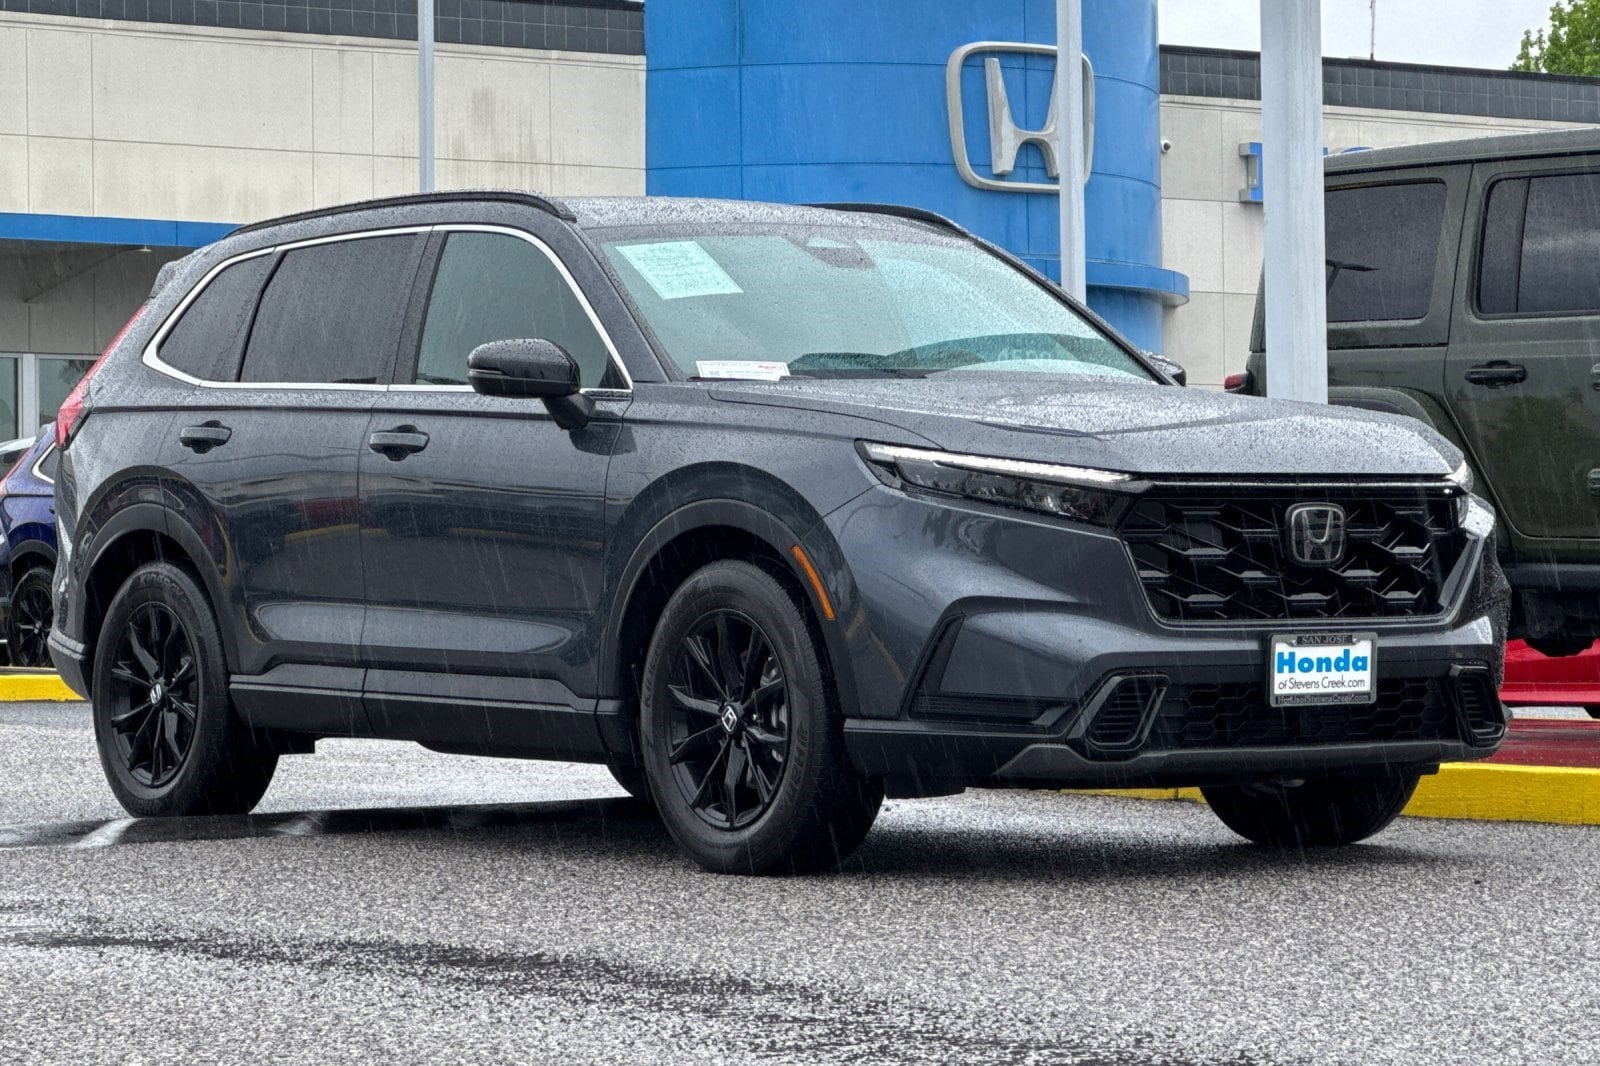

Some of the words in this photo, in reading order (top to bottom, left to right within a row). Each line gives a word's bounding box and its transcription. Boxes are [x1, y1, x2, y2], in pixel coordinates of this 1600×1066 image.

[1301, 636, 1321, 645] SAN
[1277, 648, 1368, 674] Honda
[1278, 680, 1288, 690] of
[1288, 677, 1320, 690] Stevens
[1321, 674, 1365, 689] Creek.com
